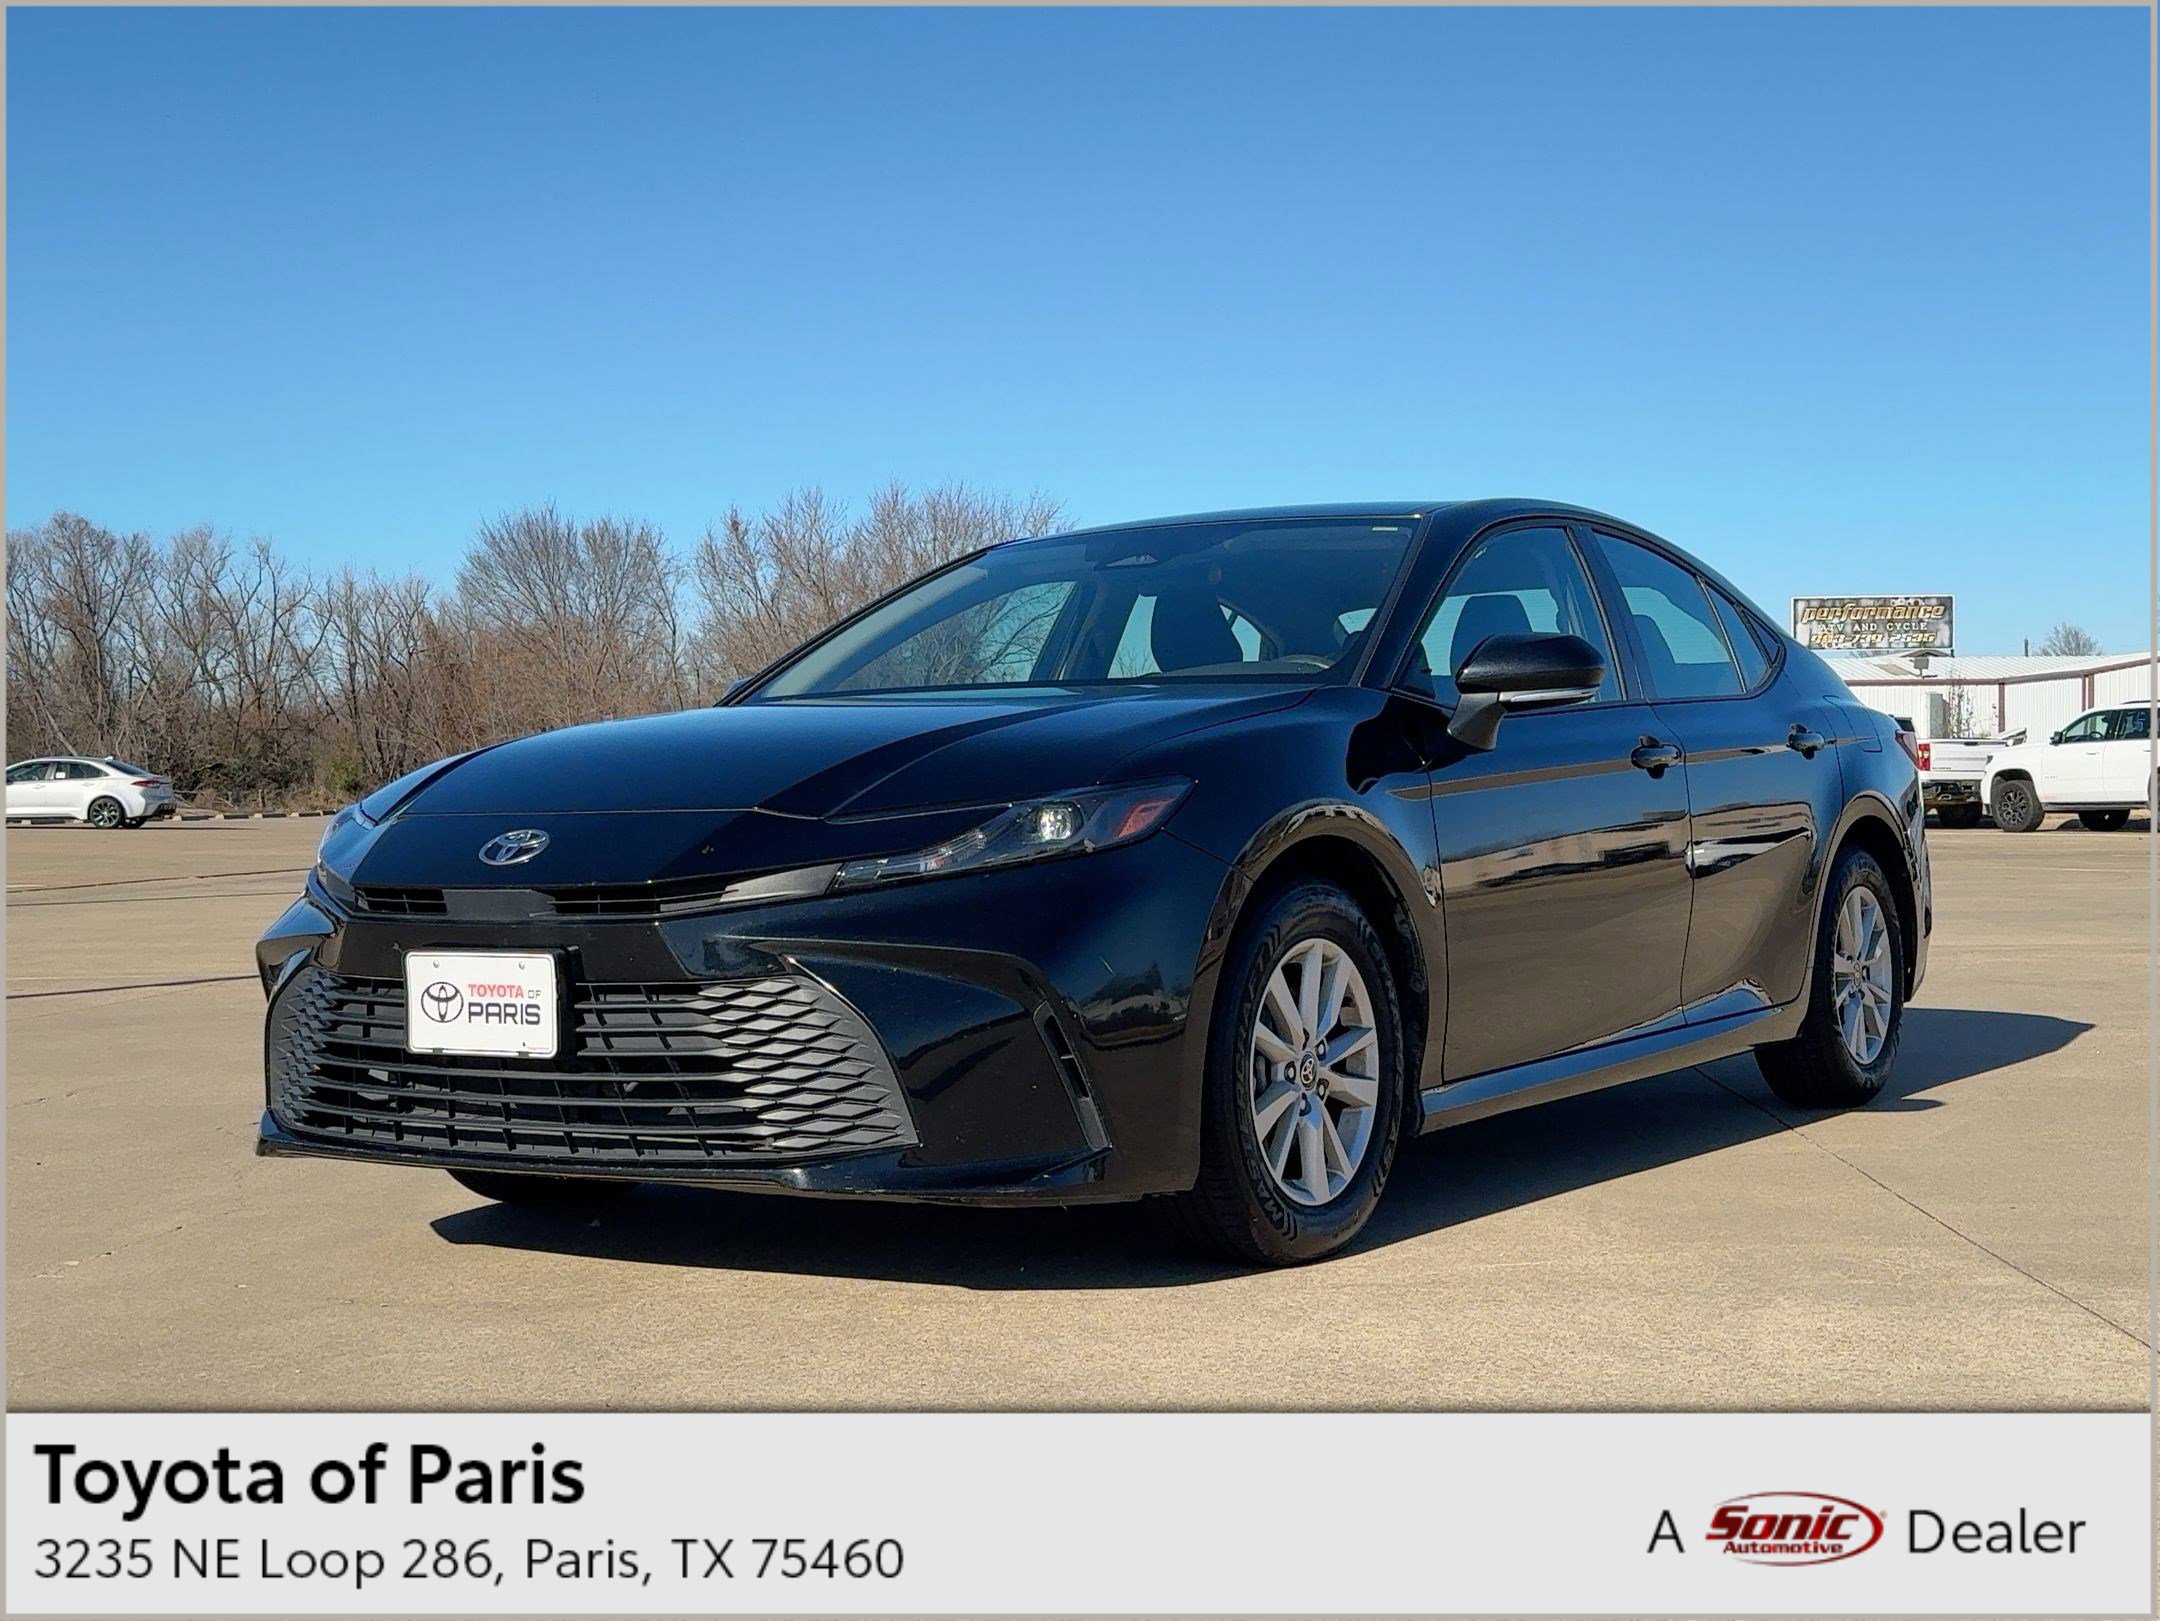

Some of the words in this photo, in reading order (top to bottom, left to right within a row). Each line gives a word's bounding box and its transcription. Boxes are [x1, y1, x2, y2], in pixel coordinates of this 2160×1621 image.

[1802, 604, 1944, 622] performance
[1819, 623, 1844, 631] ATV
[1853, 622, 1877, 631] AND
[1886, 622, 1928, 631] CYCLE
[468, 984, 524, 998] TOYOTA
[528, 990, 541, 999] OF
[468, 1002, 541, 1025] PARIS
